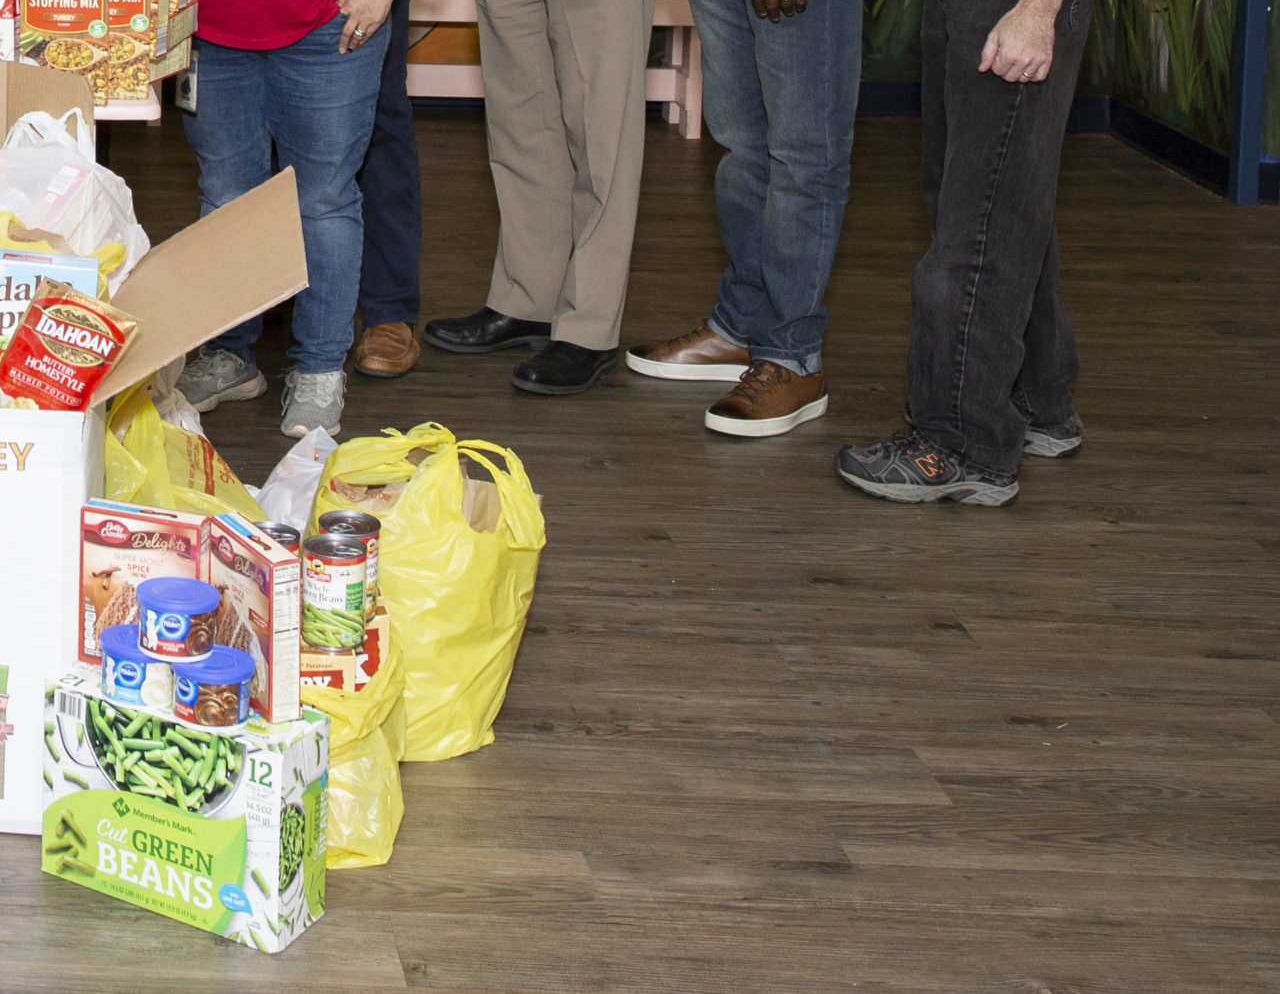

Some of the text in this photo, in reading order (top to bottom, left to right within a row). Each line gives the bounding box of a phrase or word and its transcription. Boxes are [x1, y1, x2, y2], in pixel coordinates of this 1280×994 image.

[34, 314, 116, 357] IDAHOAN
[25, 356, 86, 394] HOMESTYLE
[42, 354, 78, 377] BUTTERY
[101, 528, 129, 540] Crocker
[105, 523, 124, 535] Betty
[131, 533, 187, 553] Delights
[114, 552, 165, 568] SUPER MOIST
[126, 563, 151, 574] SPICE
[162, 619, 182, 629] Pillsbury
[249, 758, 273, 788] 12
[132, 808, 194, 836] Member's Mark
[96, 818, 214, 876] Cut GREEN
[97, 840, 214, 910] BEANS
